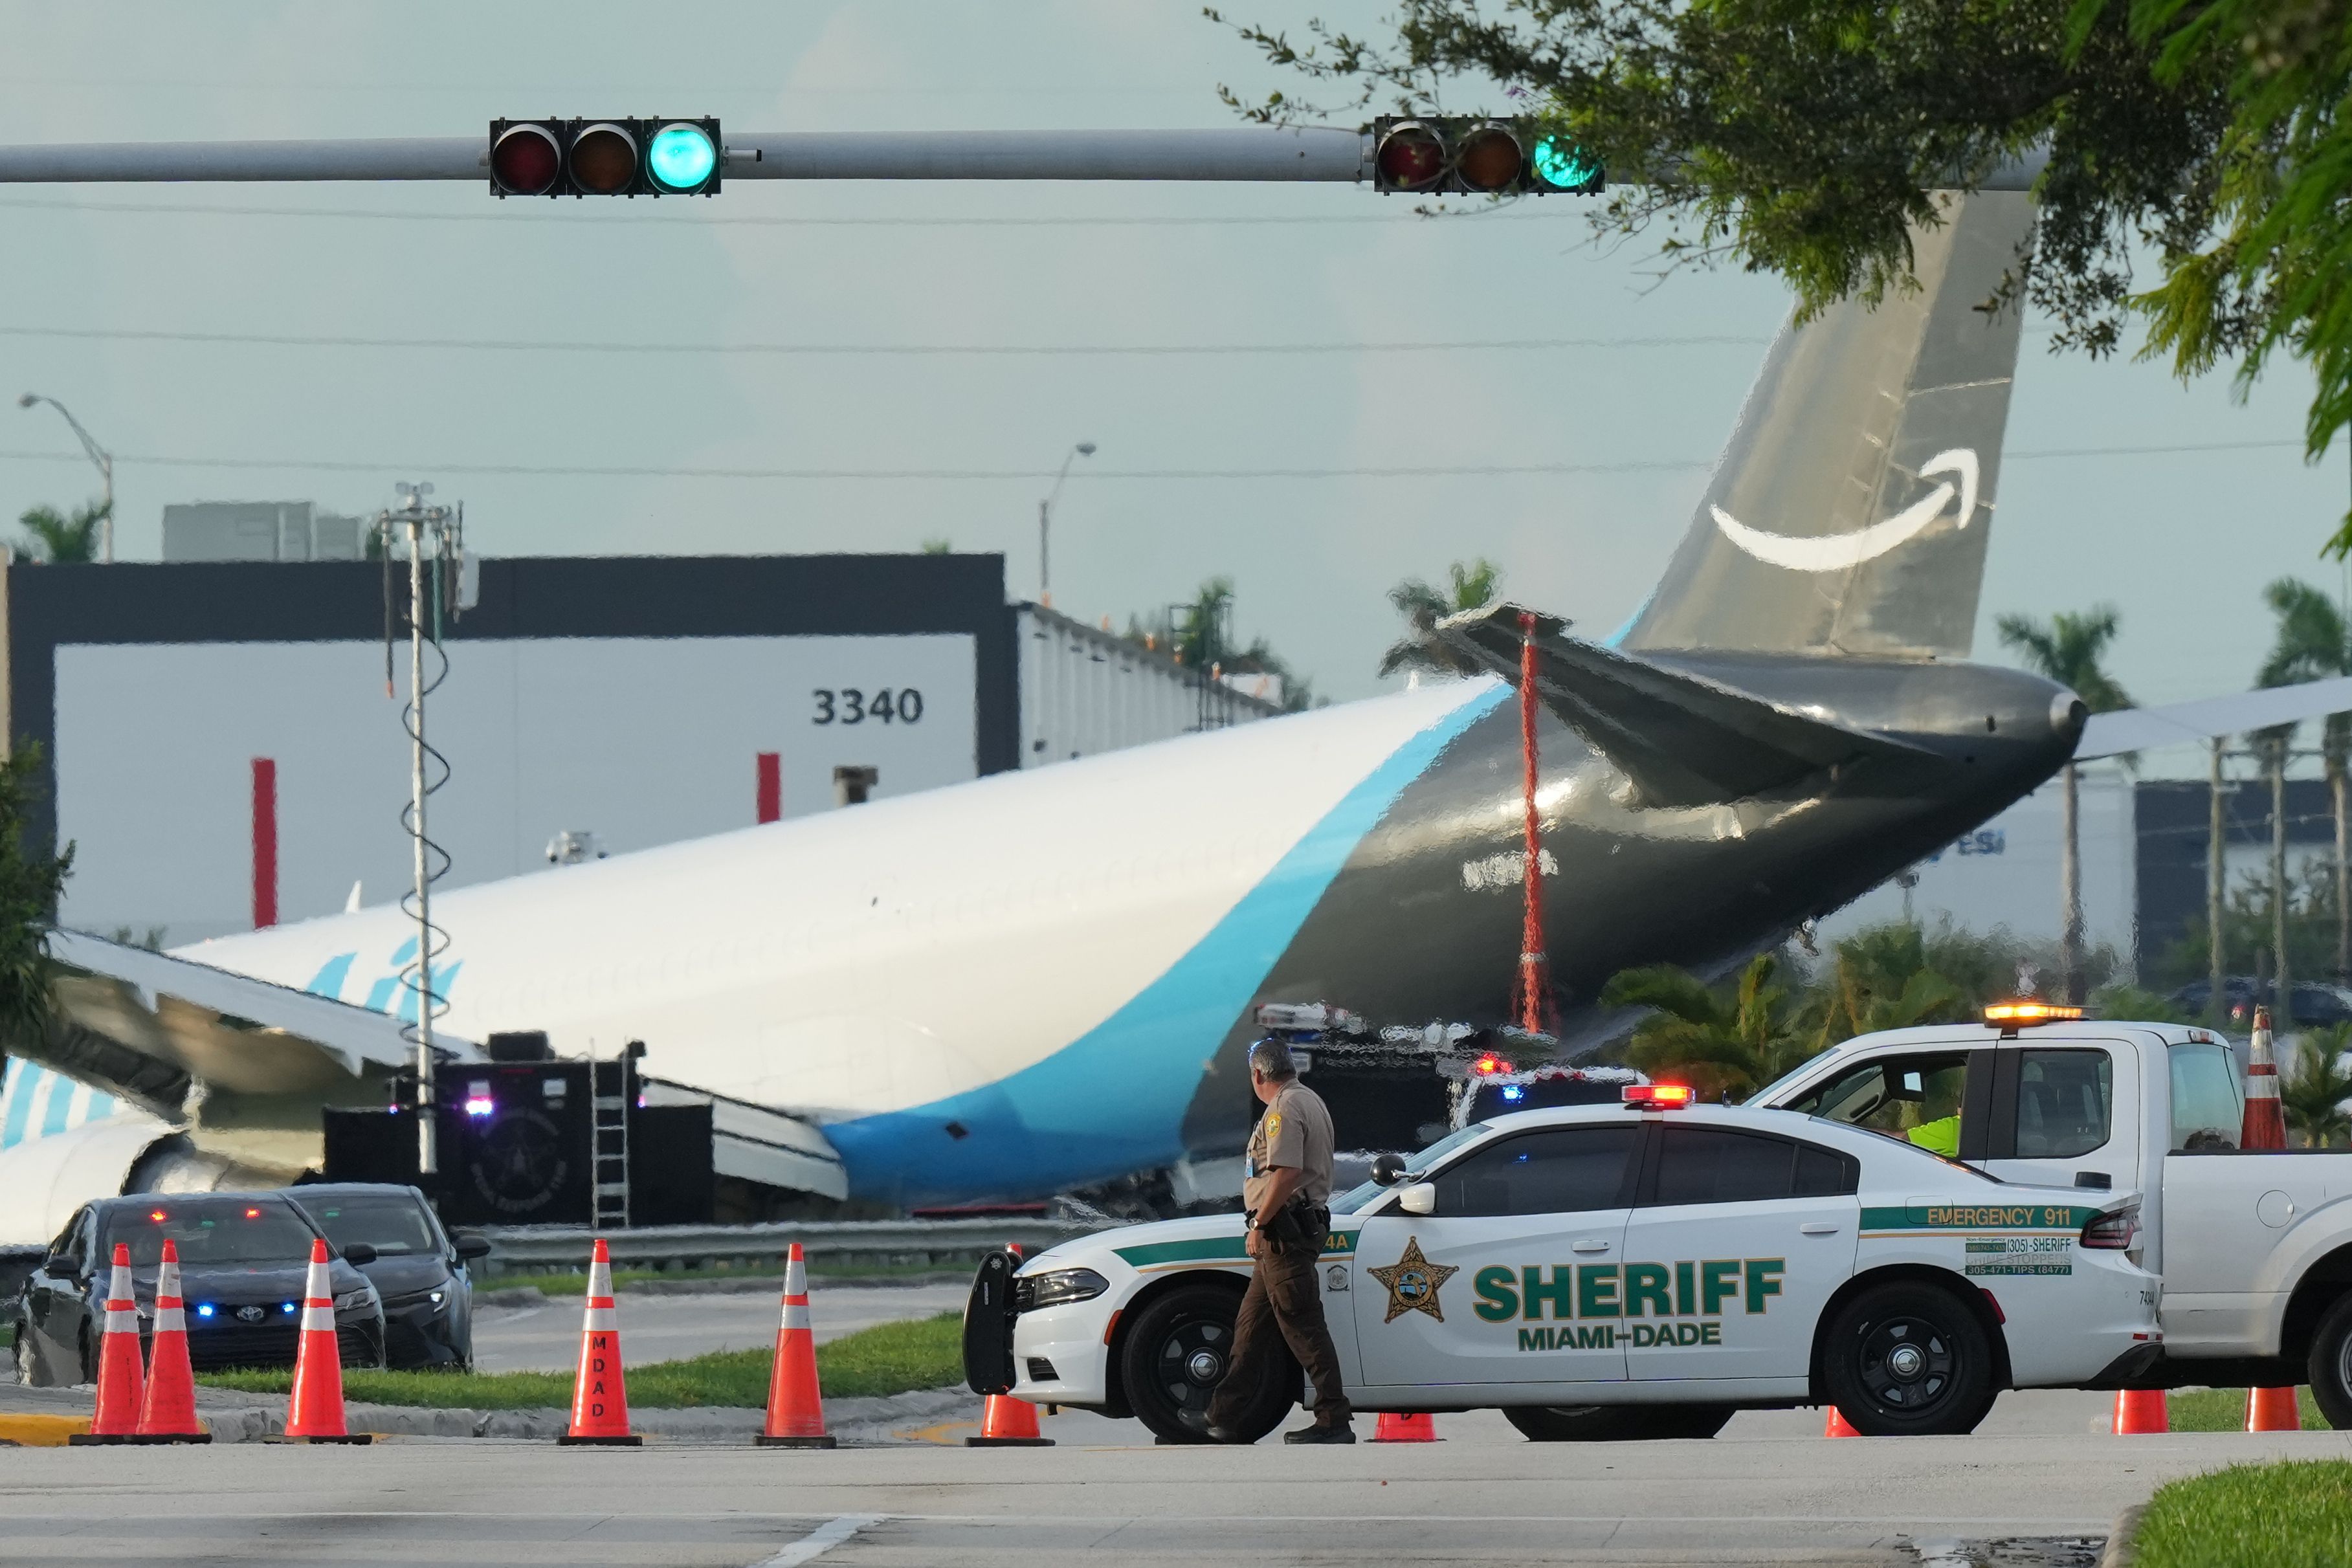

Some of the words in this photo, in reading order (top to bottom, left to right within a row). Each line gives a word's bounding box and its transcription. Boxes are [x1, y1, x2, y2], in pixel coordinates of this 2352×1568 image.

[812, 688, 923, 725] 3340
[1928, 1208, 2034, 1226] EMERGENCY
[2045, 1208, 2070, 1226] 911
[1968, 1266, 2035, 1274] 305-471-TIPS
[2038, 1266, 2069, 1275] (8477)
[2007, 1253, 2071, 1264] STOPPERS
[1472, 1257, 1786, 1323] SHERIFF
[1518, 1321, 1722, 1351] MIAMI-DADE
